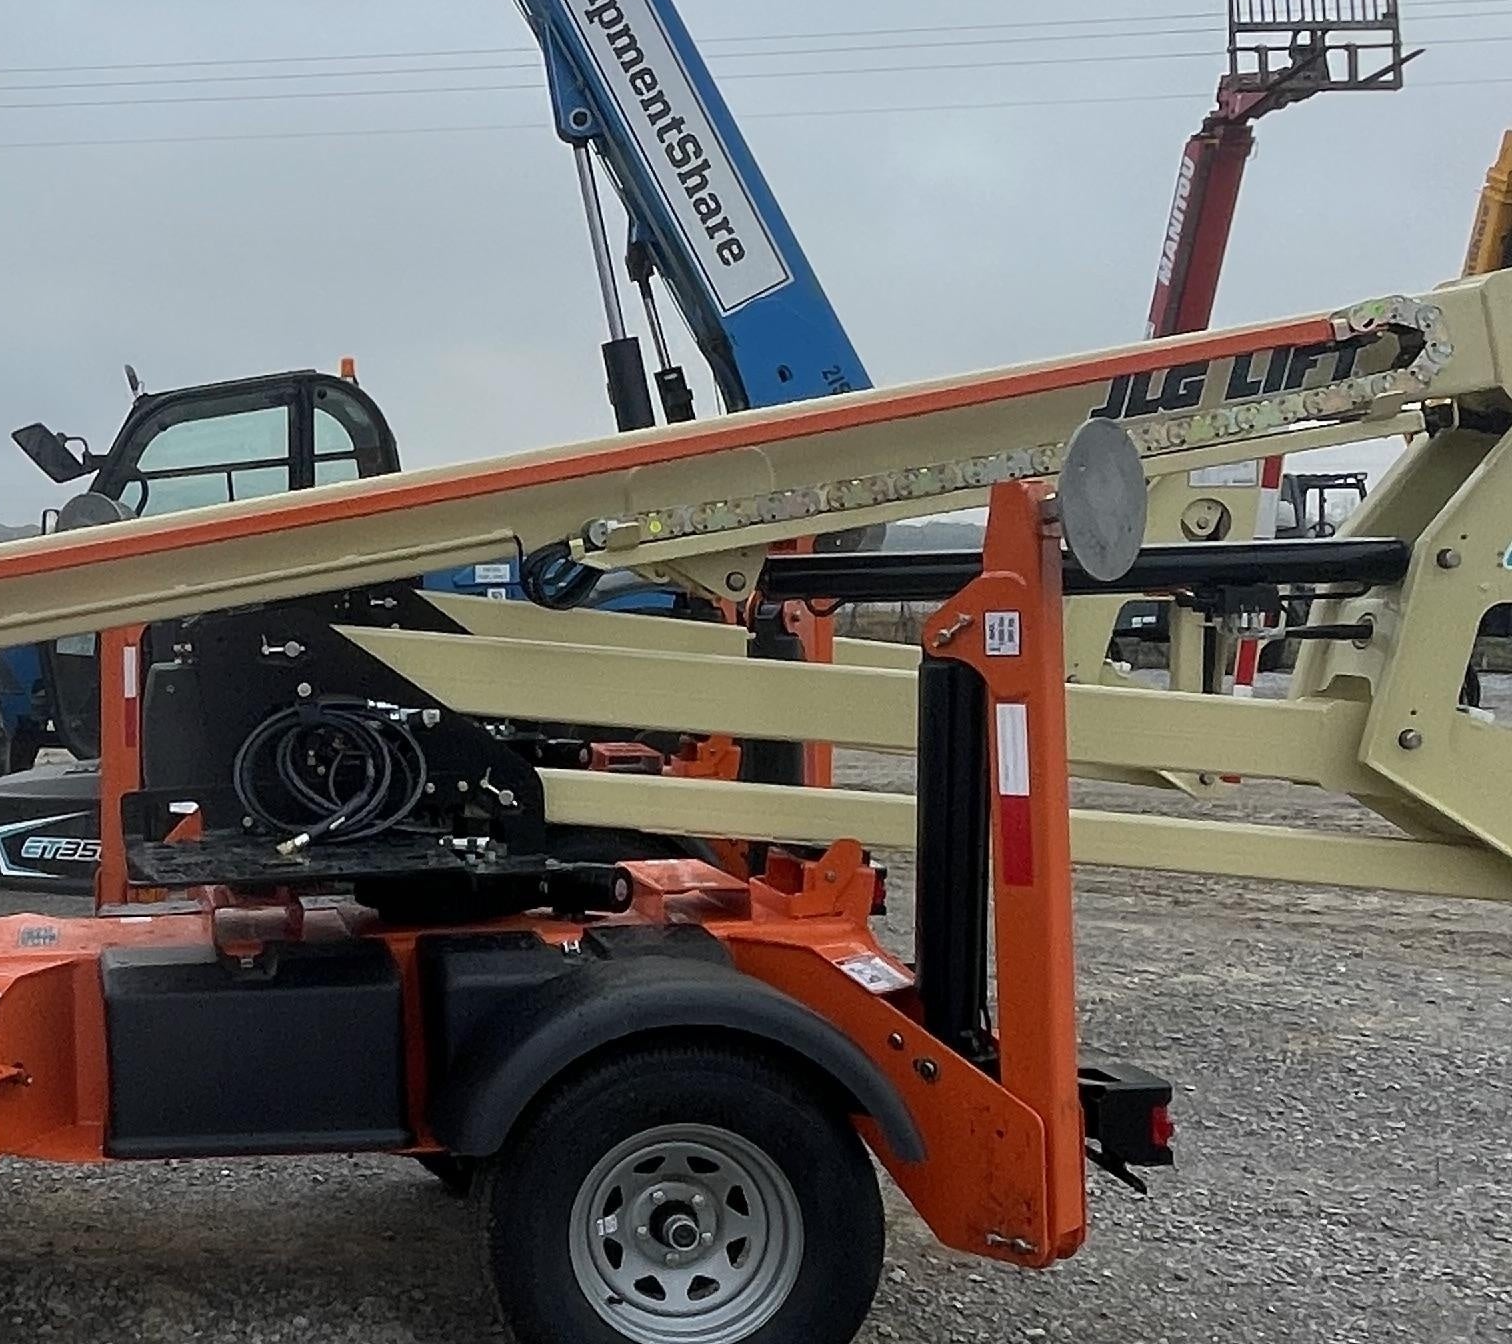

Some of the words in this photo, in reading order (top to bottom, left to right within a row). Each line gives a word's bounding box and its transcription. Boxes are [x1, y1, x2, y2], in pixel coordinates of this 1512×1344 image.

[1158, 156, 1196, 287] MANITOU
[1088, 359, 1210, 419] JLG
[1224, 340, 1364, 400] LIFT
